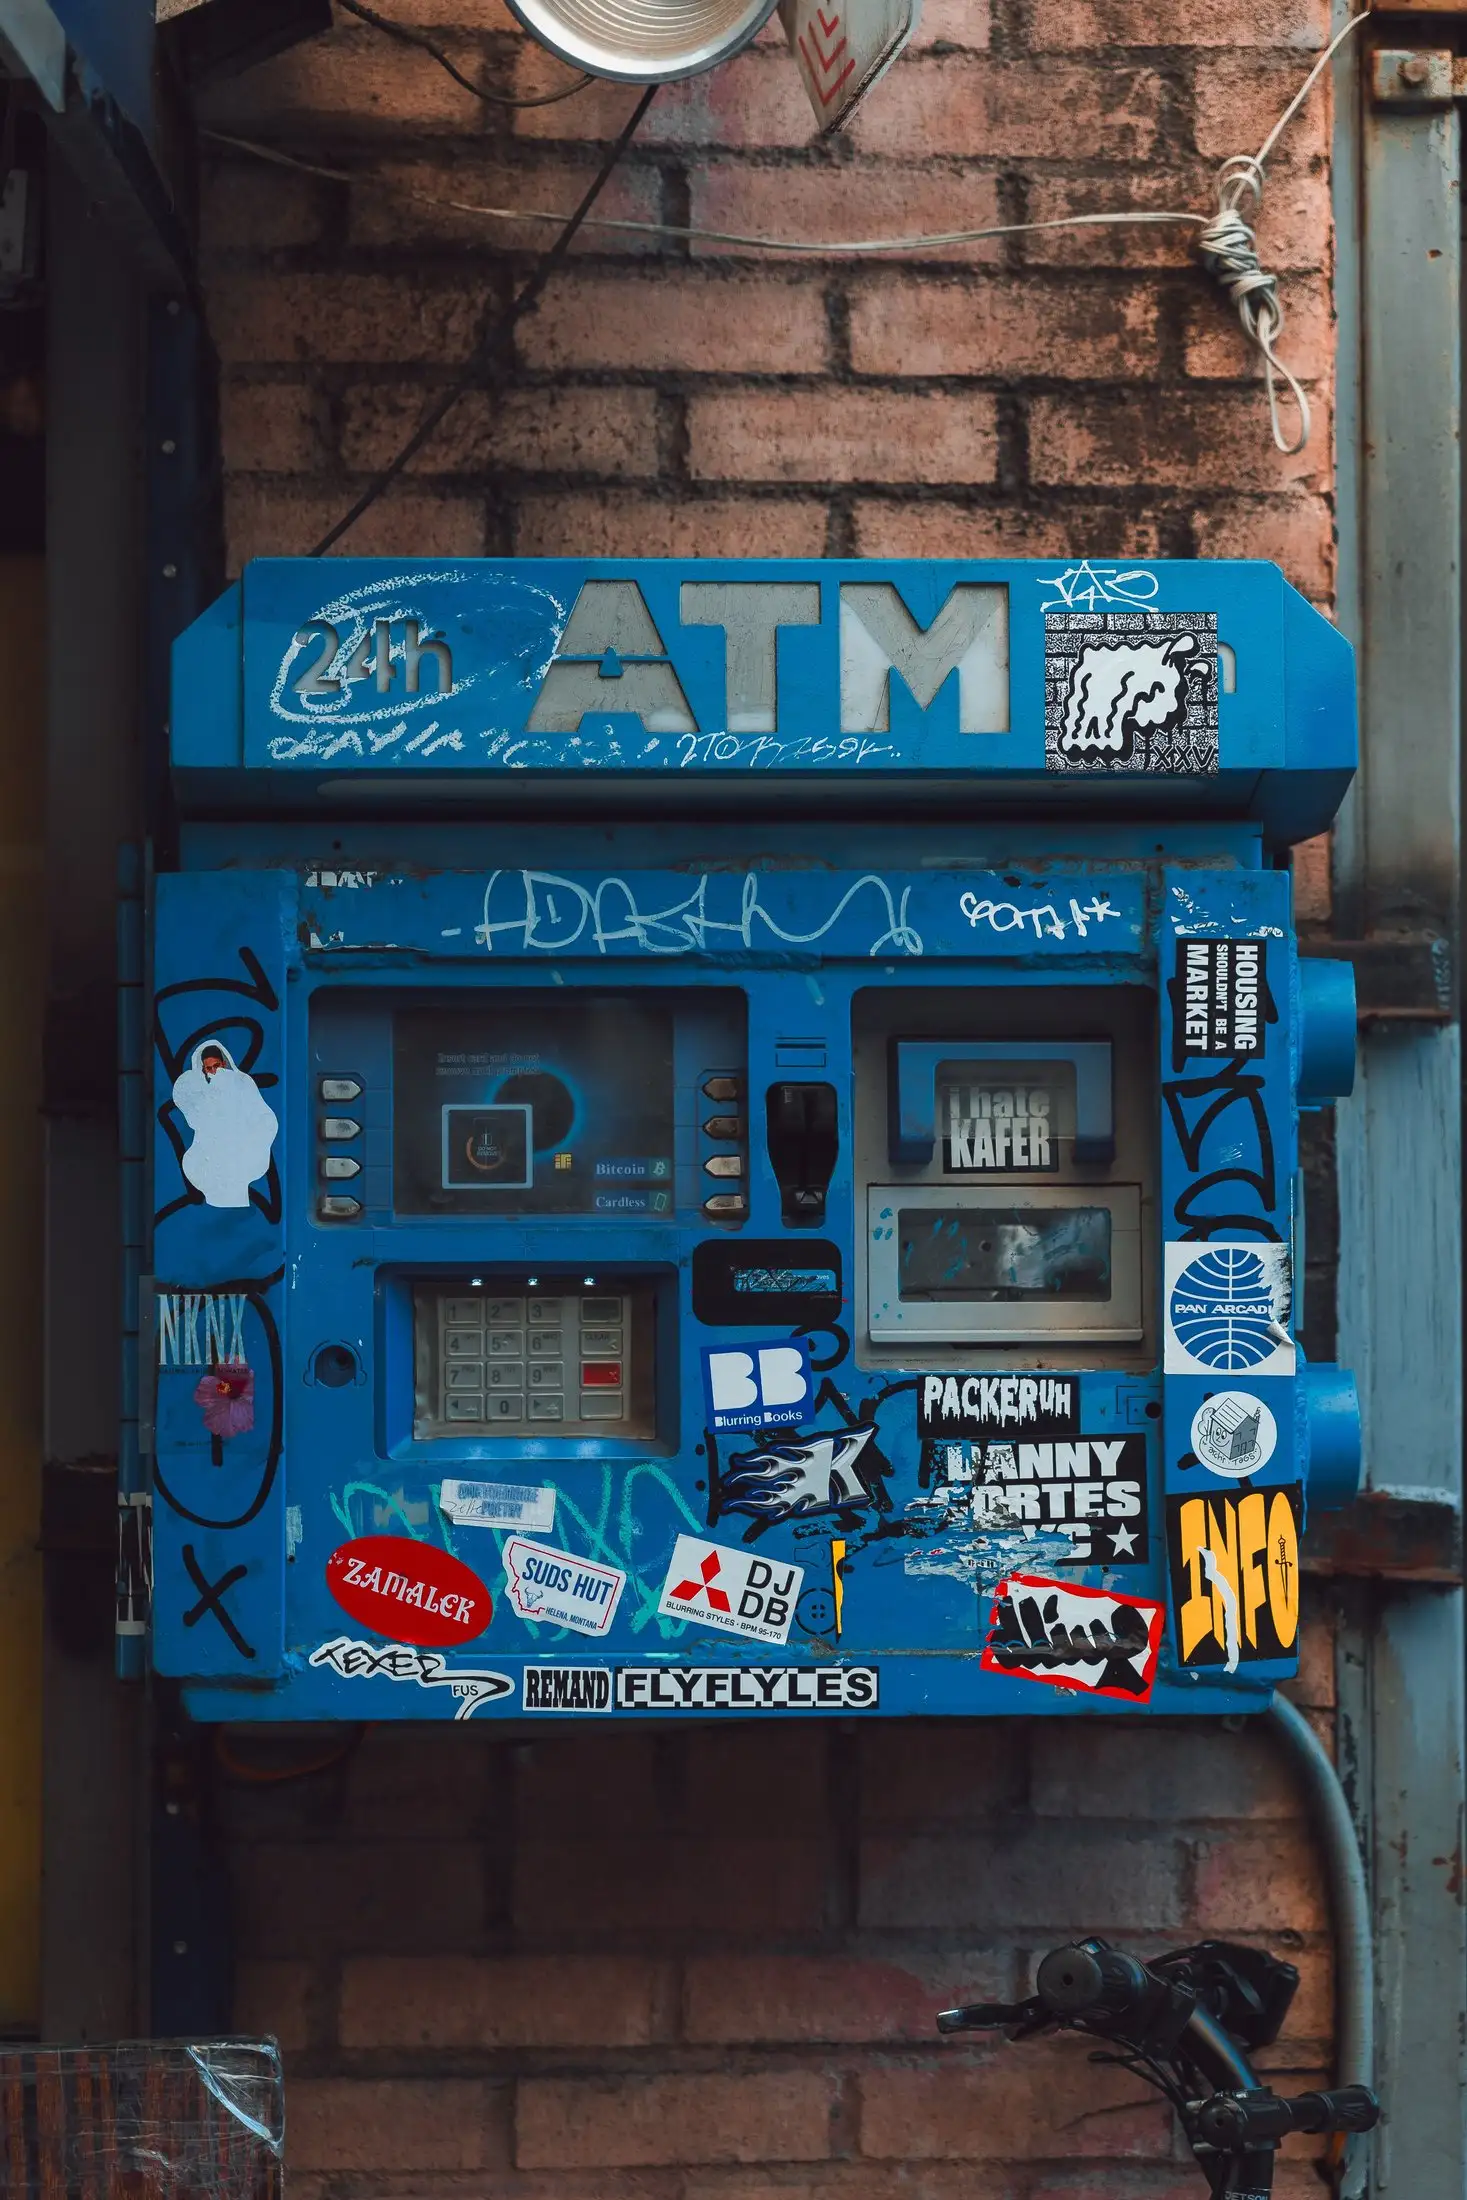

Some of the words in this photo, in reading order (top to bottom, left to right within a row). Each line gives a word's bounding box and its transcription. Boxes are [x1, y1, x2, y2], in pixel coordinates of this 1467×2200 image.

[293, 619, 453, 693] 24h
[525, 579, 1010, 735] ATM
[1152, 744, 1216, 770] XXV
[1215, 944, 1229, 1011] SHOULDN'T
[1185, 944, 1209, 1050] MARKET
[1234, 945, 1258, 1050] HOUSING
[1215, 1018, 1227, 1034] BE
[1215, 1040, 1227, 1050] A
[969, 1087, 1050, 1119] hate
[950, 1117, 1051, 1168] KAFER
[596, 1162, 646, 1175] Bitcoin
[596, 1196, 646, 1208] Cardless
[450, 1304, 457, 1319] 1
[490, 1305, 500, 1318] 2
[532, 1304, 542, 1318] 3
[1175, 1303, 1207, 1314] PAN
[157, 1293, 249, 1366] NKNX
[450, 1337, 460, 1350] 4
[492, 1337, 501, 1350] 5
[532, 1336, 542, 1349] 6
[450, 1369, 460, 1384] 7
[491, 1369, 501, 1384] 8
[532, 1369, 542, 1384] 9
[709, 1347, 807, 1411] BB
[500, 1401, 509, 1414] 0
[714, 1414, 762, 1427] Blurring
[763, 1410, 803, 1423] Books
[522, 1557, 572, 1593] SUDS
[572, 1573, 614, 1606] HUT
[746, 1559, 795, 1597] DJ
[1180, 1491, 1299, 1662] INFO
[343, 1557, 475, 1624] ZAMALEK
[545, 1606, 569, 1622] HELENA,
[569, 1613, 598, 1630] MONTANA
[665, 1600, 705, 1618] BLURRING
[706, 1612, 735, 1627] STYLES
[740, 1622, 758, 1634] BPM
[758, 1626, 782, 1640] 95-170
[737, 1589, 789, 1627] DB
[452, 1684, 479, 1697] FUS
[526, 1669, 610, 1708] REMAND
[619, 1668, 878, 1707] FLYFLYLES
